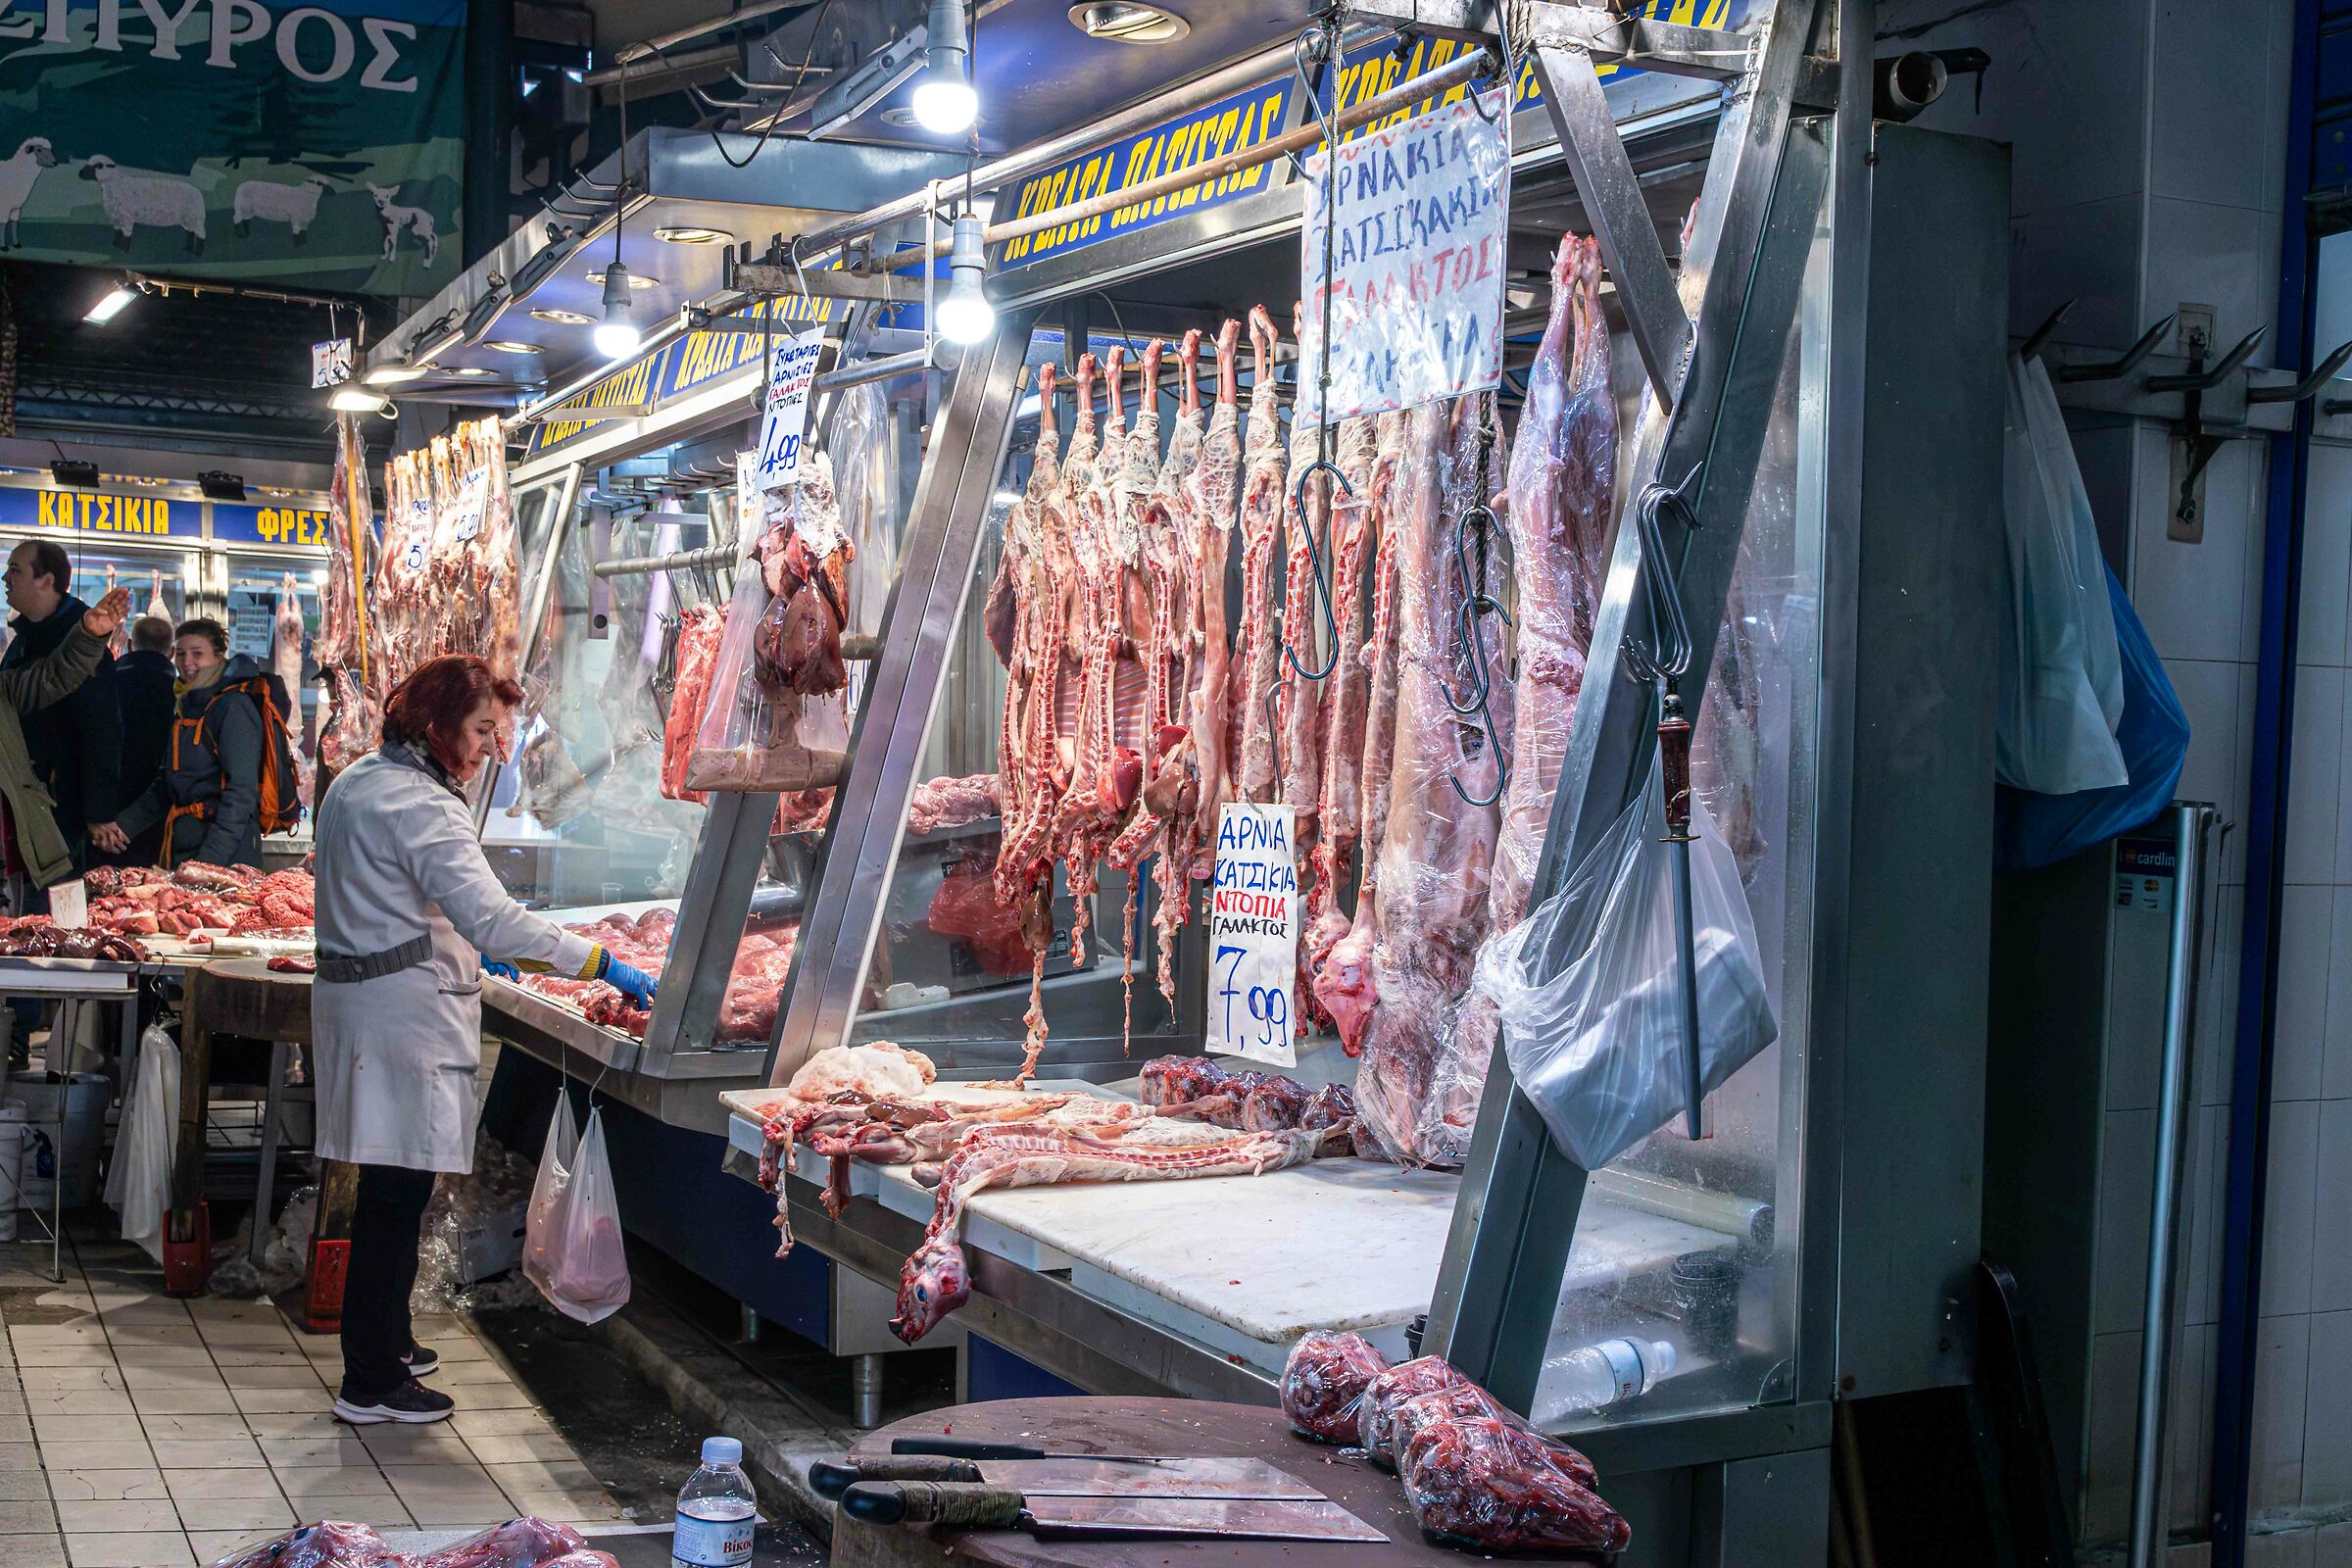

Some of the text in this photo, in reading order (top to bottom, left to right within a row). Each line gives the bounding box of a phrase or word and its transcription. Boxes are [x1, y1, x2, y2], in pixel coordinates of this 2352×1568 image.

[1004, 152, 1114, 262] ΚΡΕΑΤΑ
[768, 376, 811, 402] ΓΑΛΑΚΤΟΣ
[38, 490, 170, 535] ΚΑΤΣΙΚΙΑ
[257, 507, 329, 545] ΦΡΕΣ
[1218, 816, 1287, 853] ΑΡΝΙΑ
[1214, 858, 1296, 892] ΚΑΤΣΙΚΙΑ
[2137, 852, 2175, 867] cardlin
[1215, 890, 1287, 922] ΝΤΟΠΙΑ
[1212, 917, 1288, 939] ΓΑΛΑΚΤΟΣ
